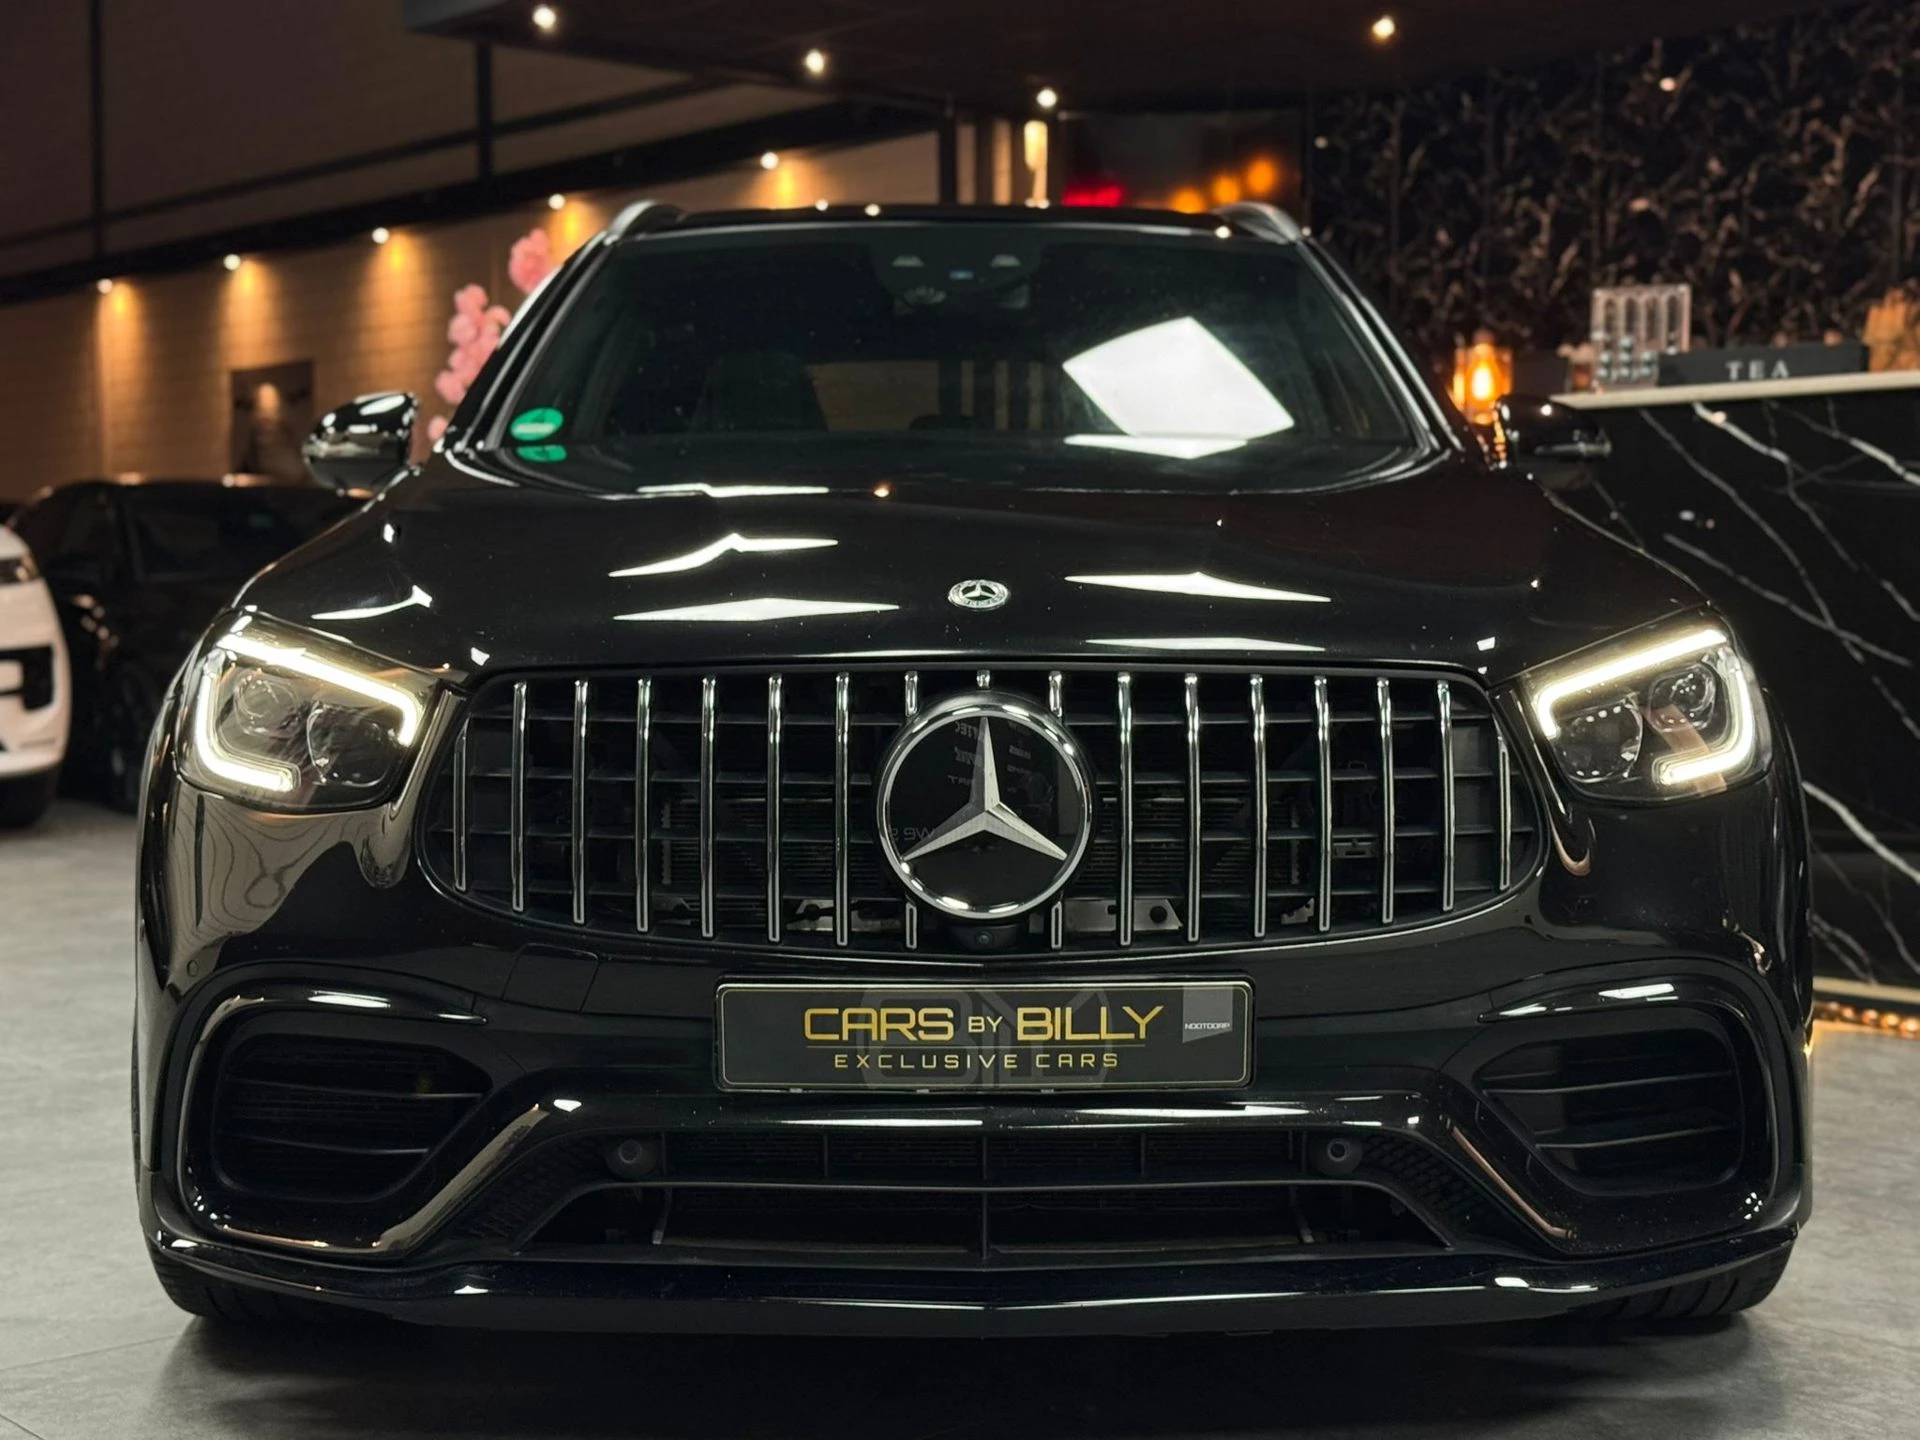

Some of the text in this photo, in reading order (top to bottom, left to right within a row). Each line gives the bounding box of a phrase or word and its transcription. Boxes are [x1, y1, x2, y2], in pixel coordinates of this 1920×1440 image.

[1725, 360, 1789, 380] TEA
[804, 1005, 1164, 1041] CARS BY BILLY
[834, 1053, 1118, 1069] EXCLUSIVE CARS
